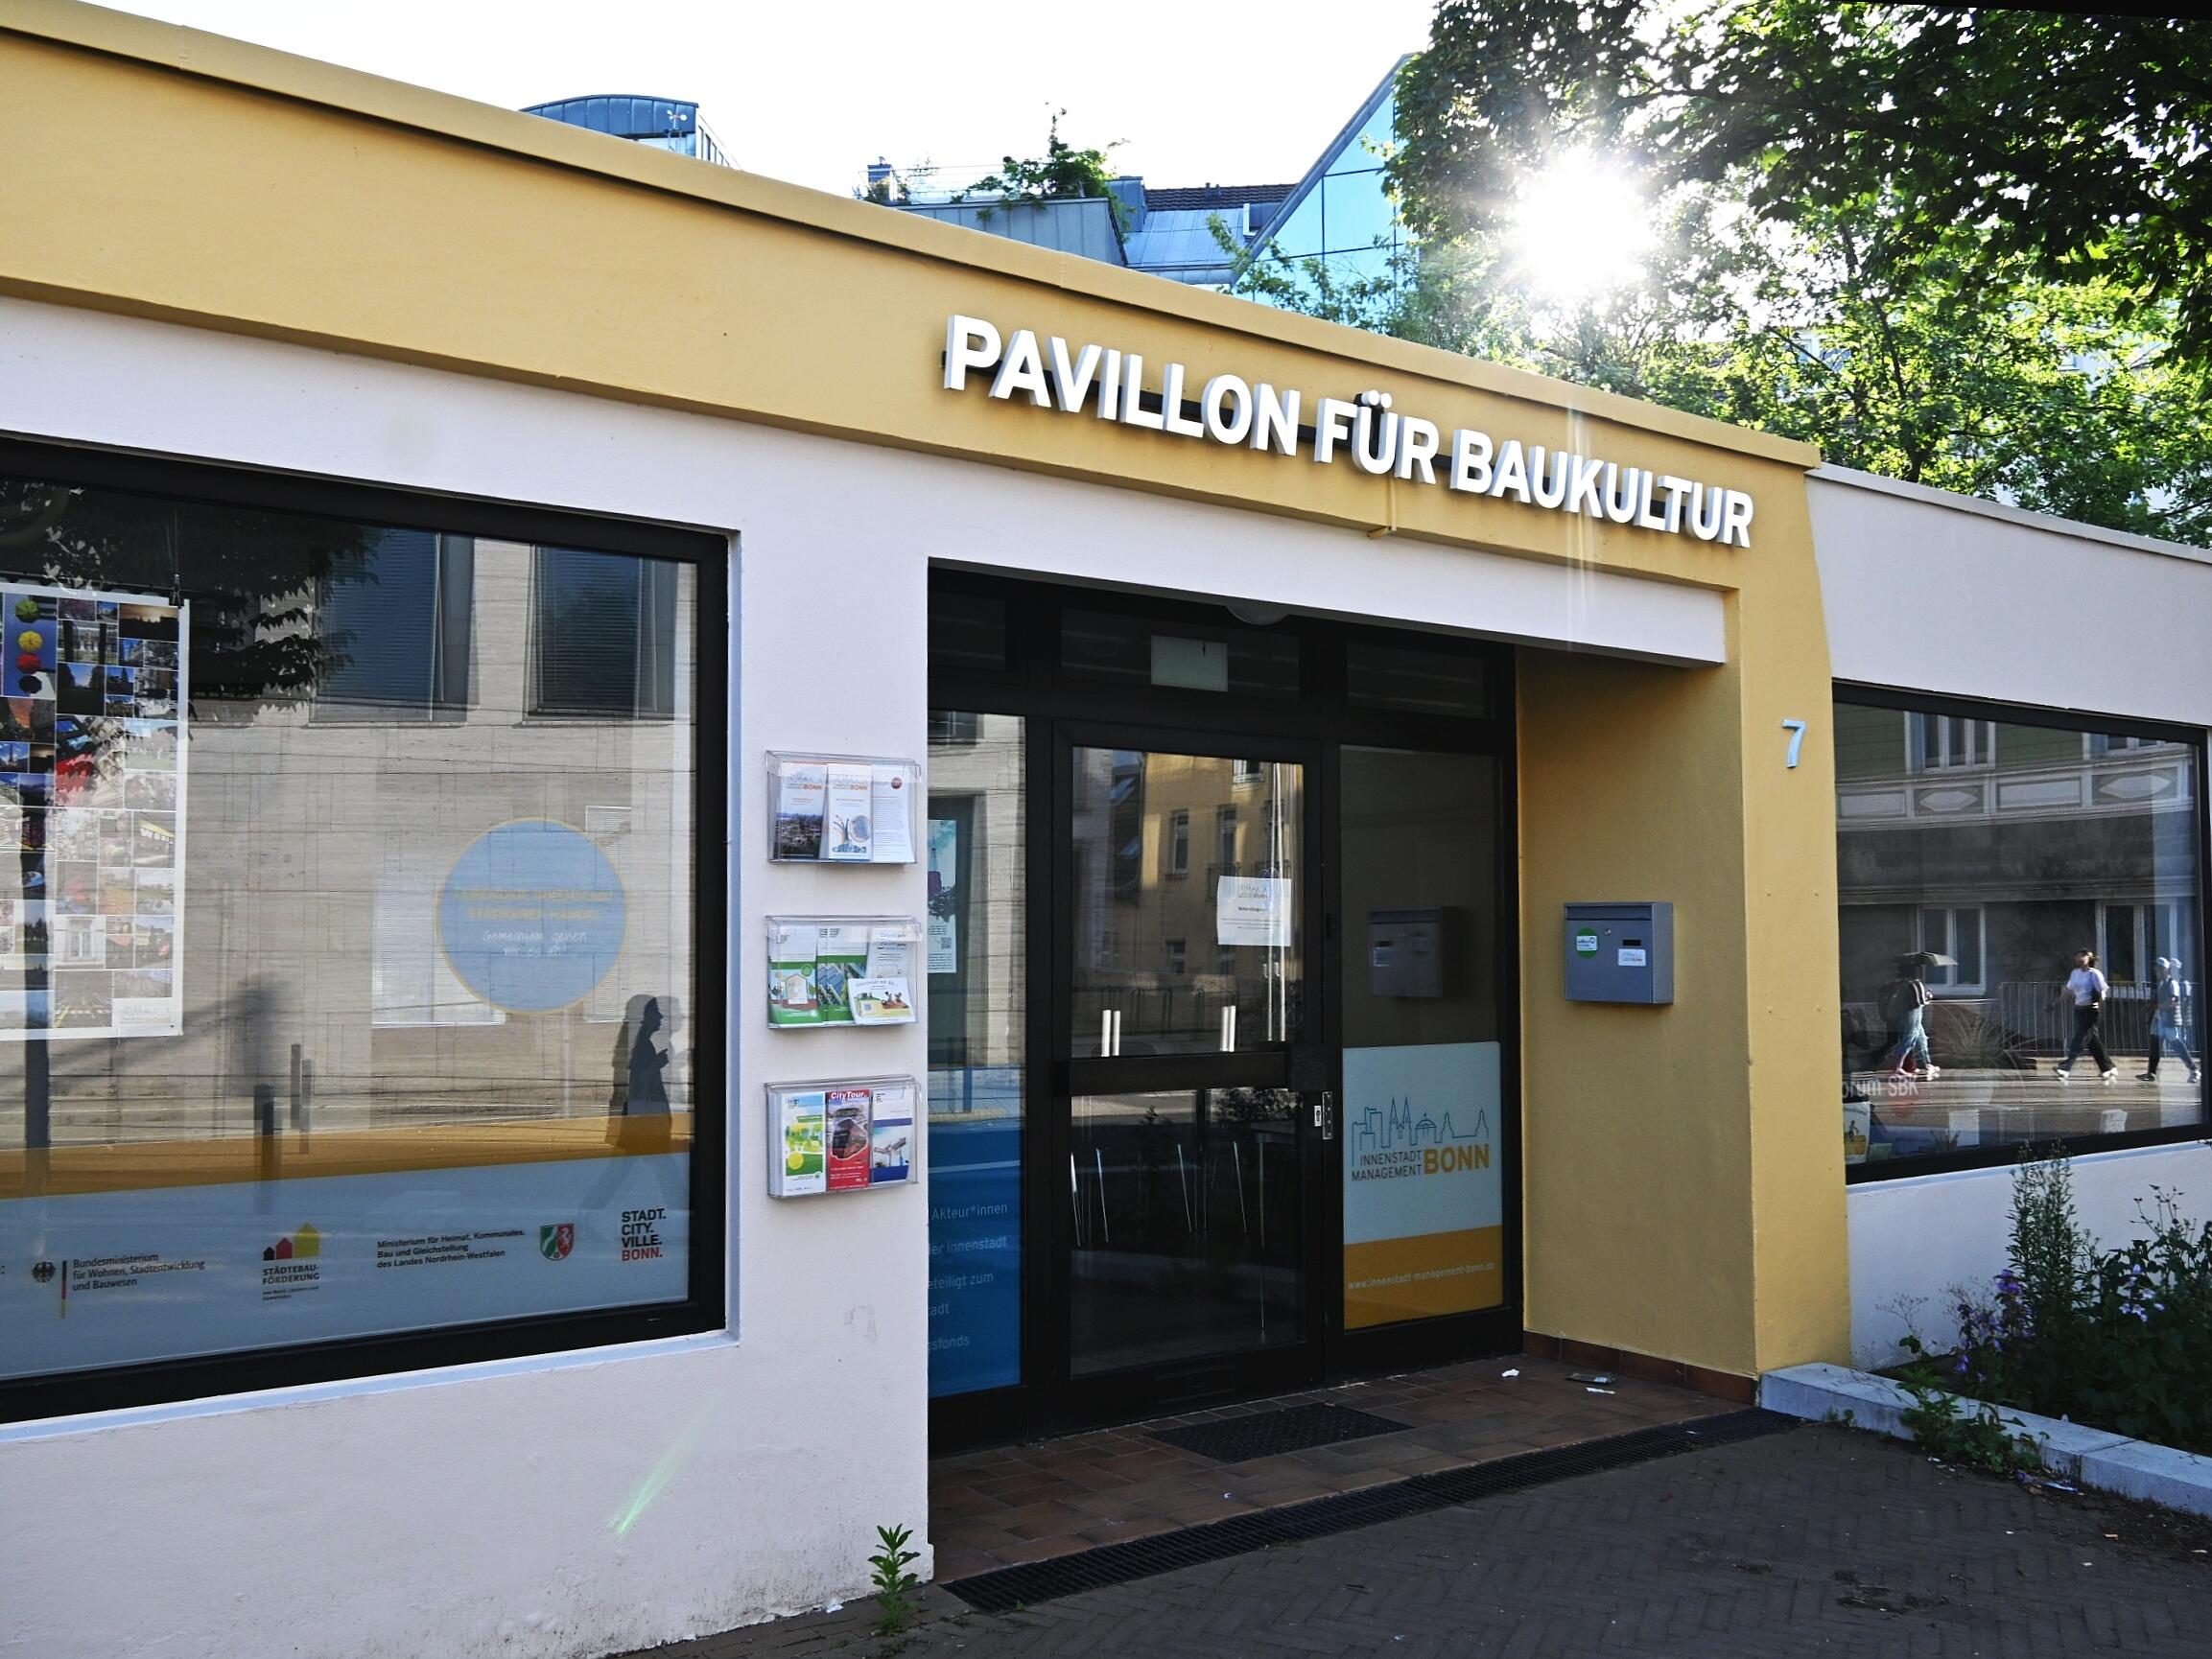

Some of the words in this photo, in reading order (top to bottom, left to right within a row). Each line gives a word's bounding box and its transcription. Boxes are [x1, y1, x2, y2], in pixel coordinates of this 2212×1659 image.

[944, 315, 1301, 456] PAVILLON
[1314, 389, 1439, 484] FÜR
[1450, 429, 1753, 548] BAUKULTUR
[1781, 719, 1805, 768] 7
[1887, 1076, 1919, 1097] SBK
[1359, 1150, 1423, 1166] INNENSTADT
[1424, 1144, 1490, 1175] BONN
[1352, 1164, 1423, 1181] MANAGEMENT
[622, 1208, 666, 1223] STADT.
[622, 1222, 654, 1235] CITY.
[377, 1238, 426, 1248] Ministerium
[622, 1234, 662, 1248] VILLE.
[946, 1235, 1008, 1254] Innenstadt
[377, 1250, 394, 1258] Bau
[395, 1248, 412, 1257] und
[412, 1244, 469, 1255] Gleichstellung
[622, 1248, 663, 1261] BONN.
[73, 1252, 159, 1269] Bundesministerium
[377, 1260, 392, 1269] des
[393, 1257, 423, 1267] Landes
[425, 1250, 506, 1263] Nordrhein-Westfalen
[73, 1270, 86, 1280] für
[88, 1268, 129, 1279] Wohnen,
[129, 1259, 206, 1276] Stadtentwicklung
[262, 1263, 320, 1276] STÄDTEBAU-
[1349, 1261, 1495, 1290] www.innenstadt-management-bonn.de
[73, 1280, 91, 1292] und
[92, 1277, 138, 1290] Bauwesen
[262, 1272, 320, 1285] FÖRDERUNG
[970, 1273, 995, 1286] zum
